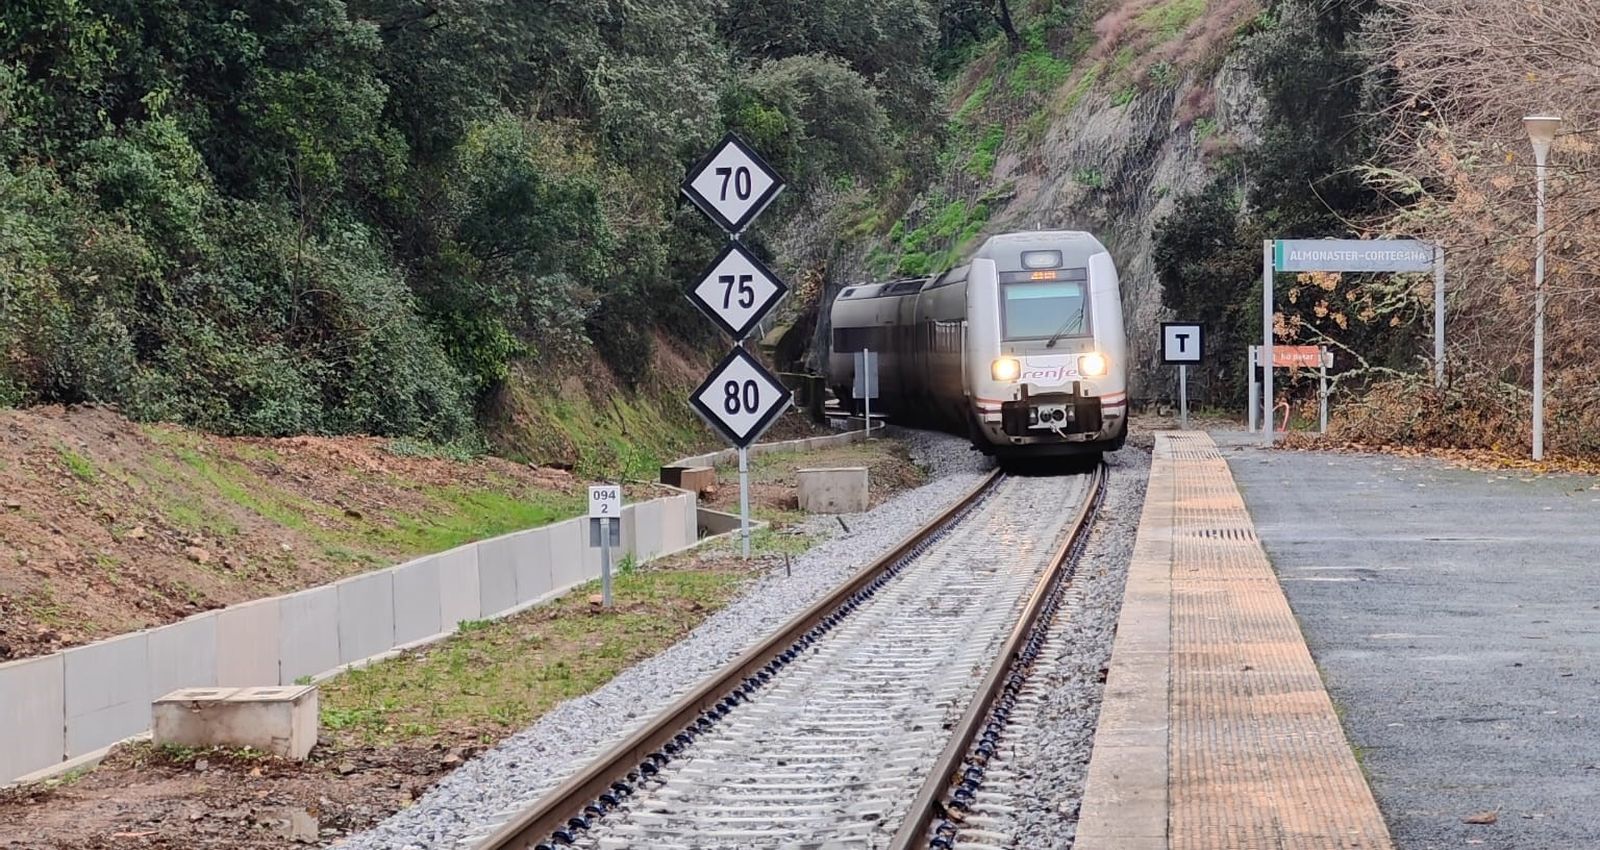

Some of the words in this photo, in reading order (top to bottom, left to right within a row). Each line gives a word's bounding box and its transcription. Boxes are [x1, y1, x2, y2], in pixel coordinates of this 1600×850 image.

[715, 166, 752, 201] 70
[718, 274, 755, 310] 75
[1175, 333, 1190, 353] T
[1022, 367, 1077, 380] renfe
[723, 379, 760, 416] 80
[593, 490, 616, 501] 094
[601, 503, 608, 514] 2
